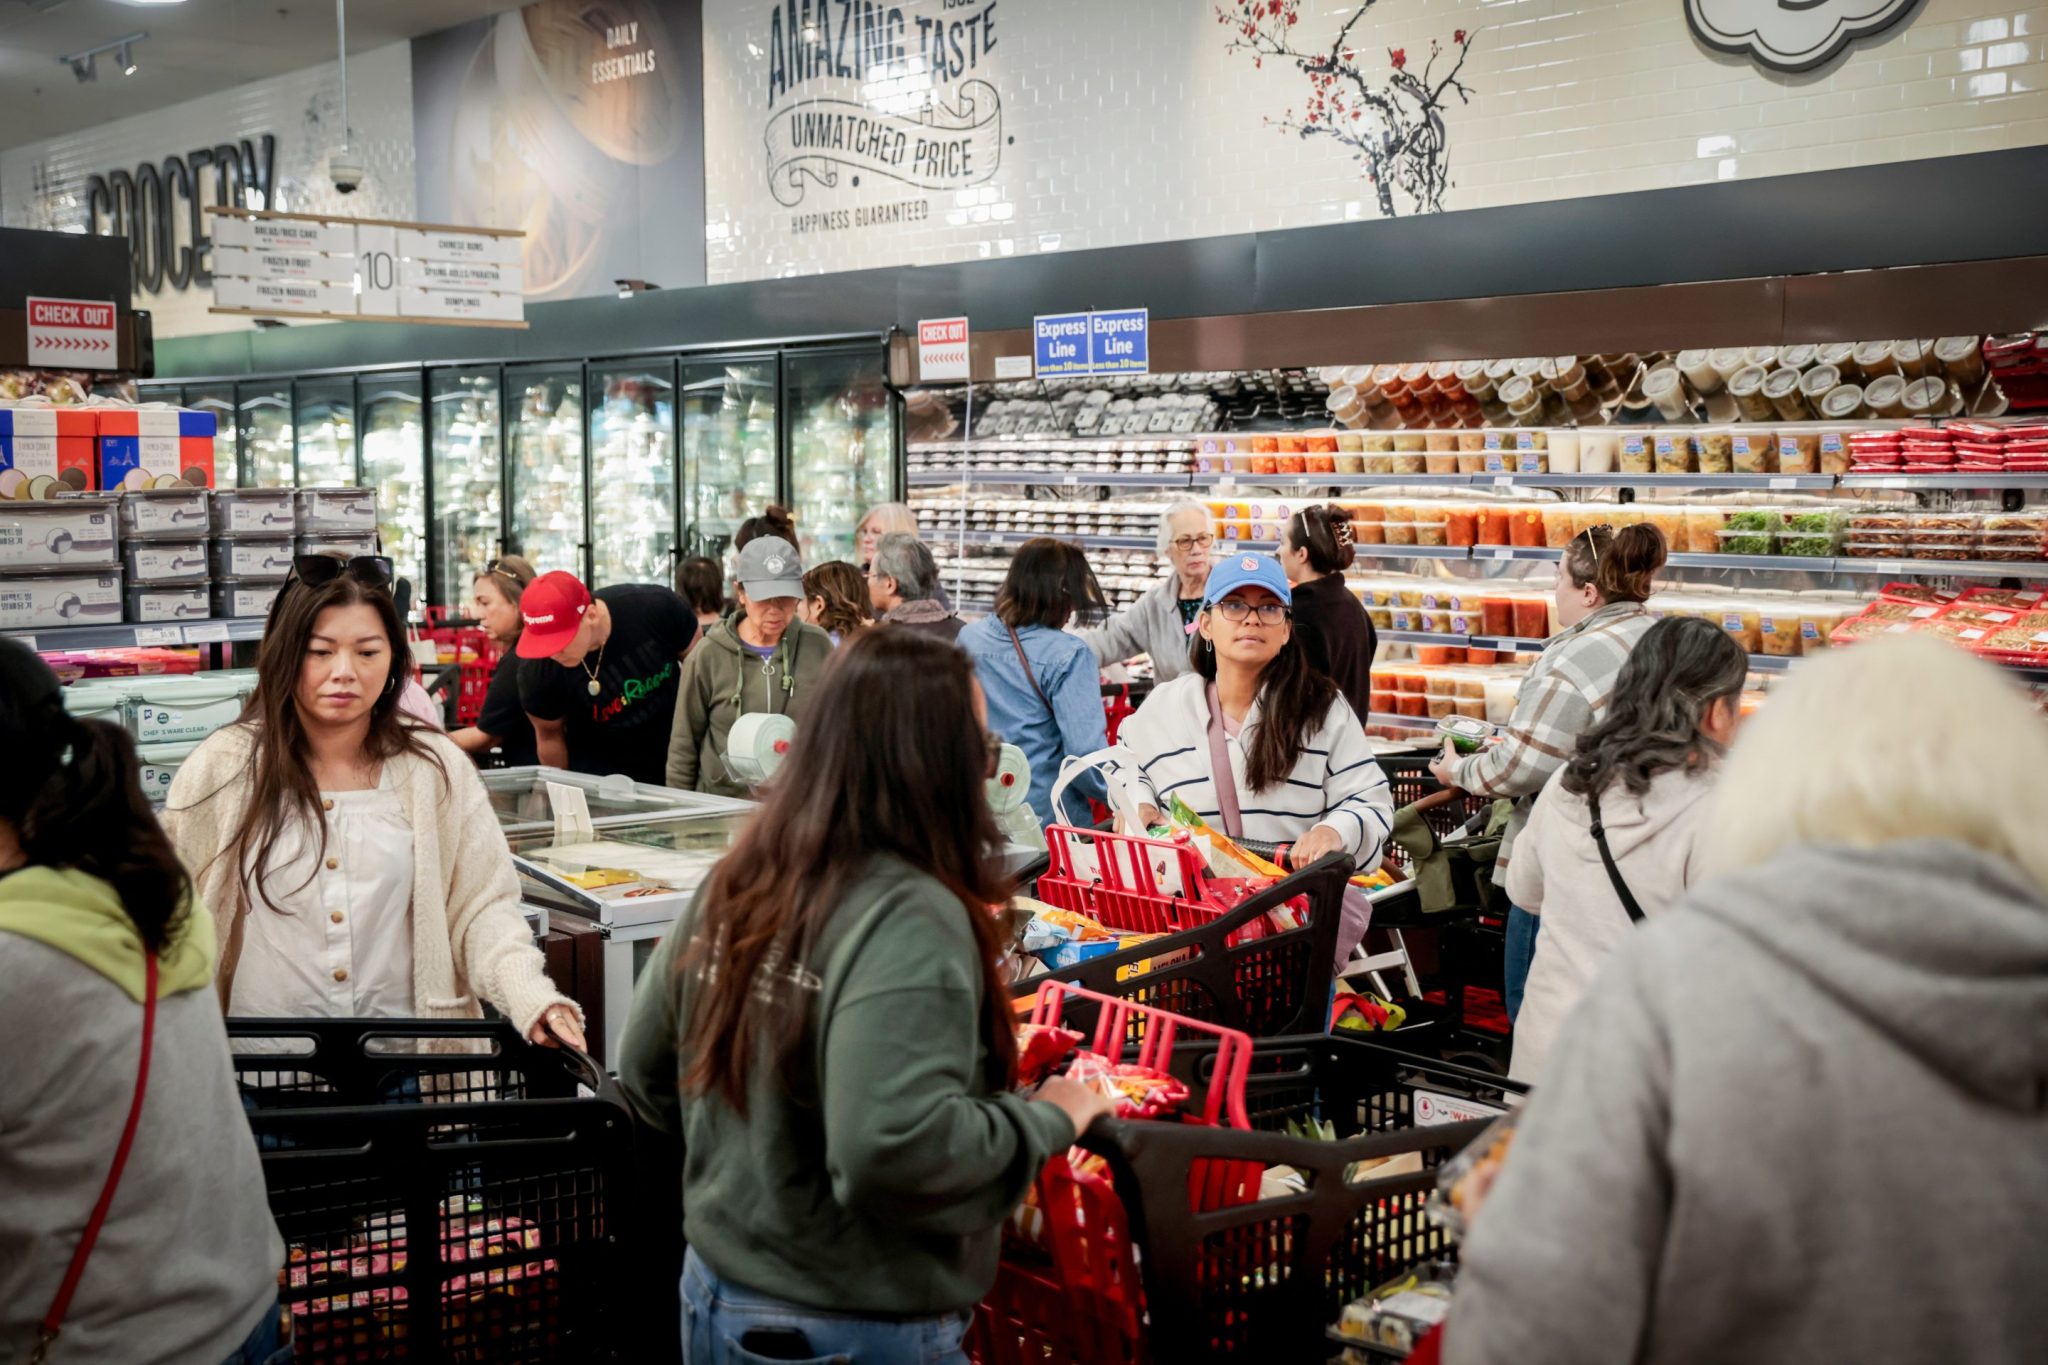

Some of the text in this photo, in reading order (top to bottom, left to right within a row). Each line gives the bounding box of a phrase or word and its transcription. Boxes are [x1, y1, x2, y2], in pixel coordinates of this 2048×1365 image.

[606, 20, 639, 50] DAILY
[591, 48, 656, 84] ESSENTIALS
[768, 0, 998, 111] AMAZING TASTE
[791, 111, 974, 178] UNMATCHED PRICE
[791, 200, 929, 235] HAPPINESS GUARANTEED
[361, 251, 393, 291] 10
[35, 304, 109, 326] CHECK OUT
[922, 322, 965, 342] CHECK OUT
[1038, 321, 1086, 340] Express
[1093, 317, 1144, 336] Express
[1049, 341, 1076, 358] Line
[1104, 337, 1133, 355] Line
[1063, 361, 1073, 371] 10
[1119, 358, 1129, 368] 10
